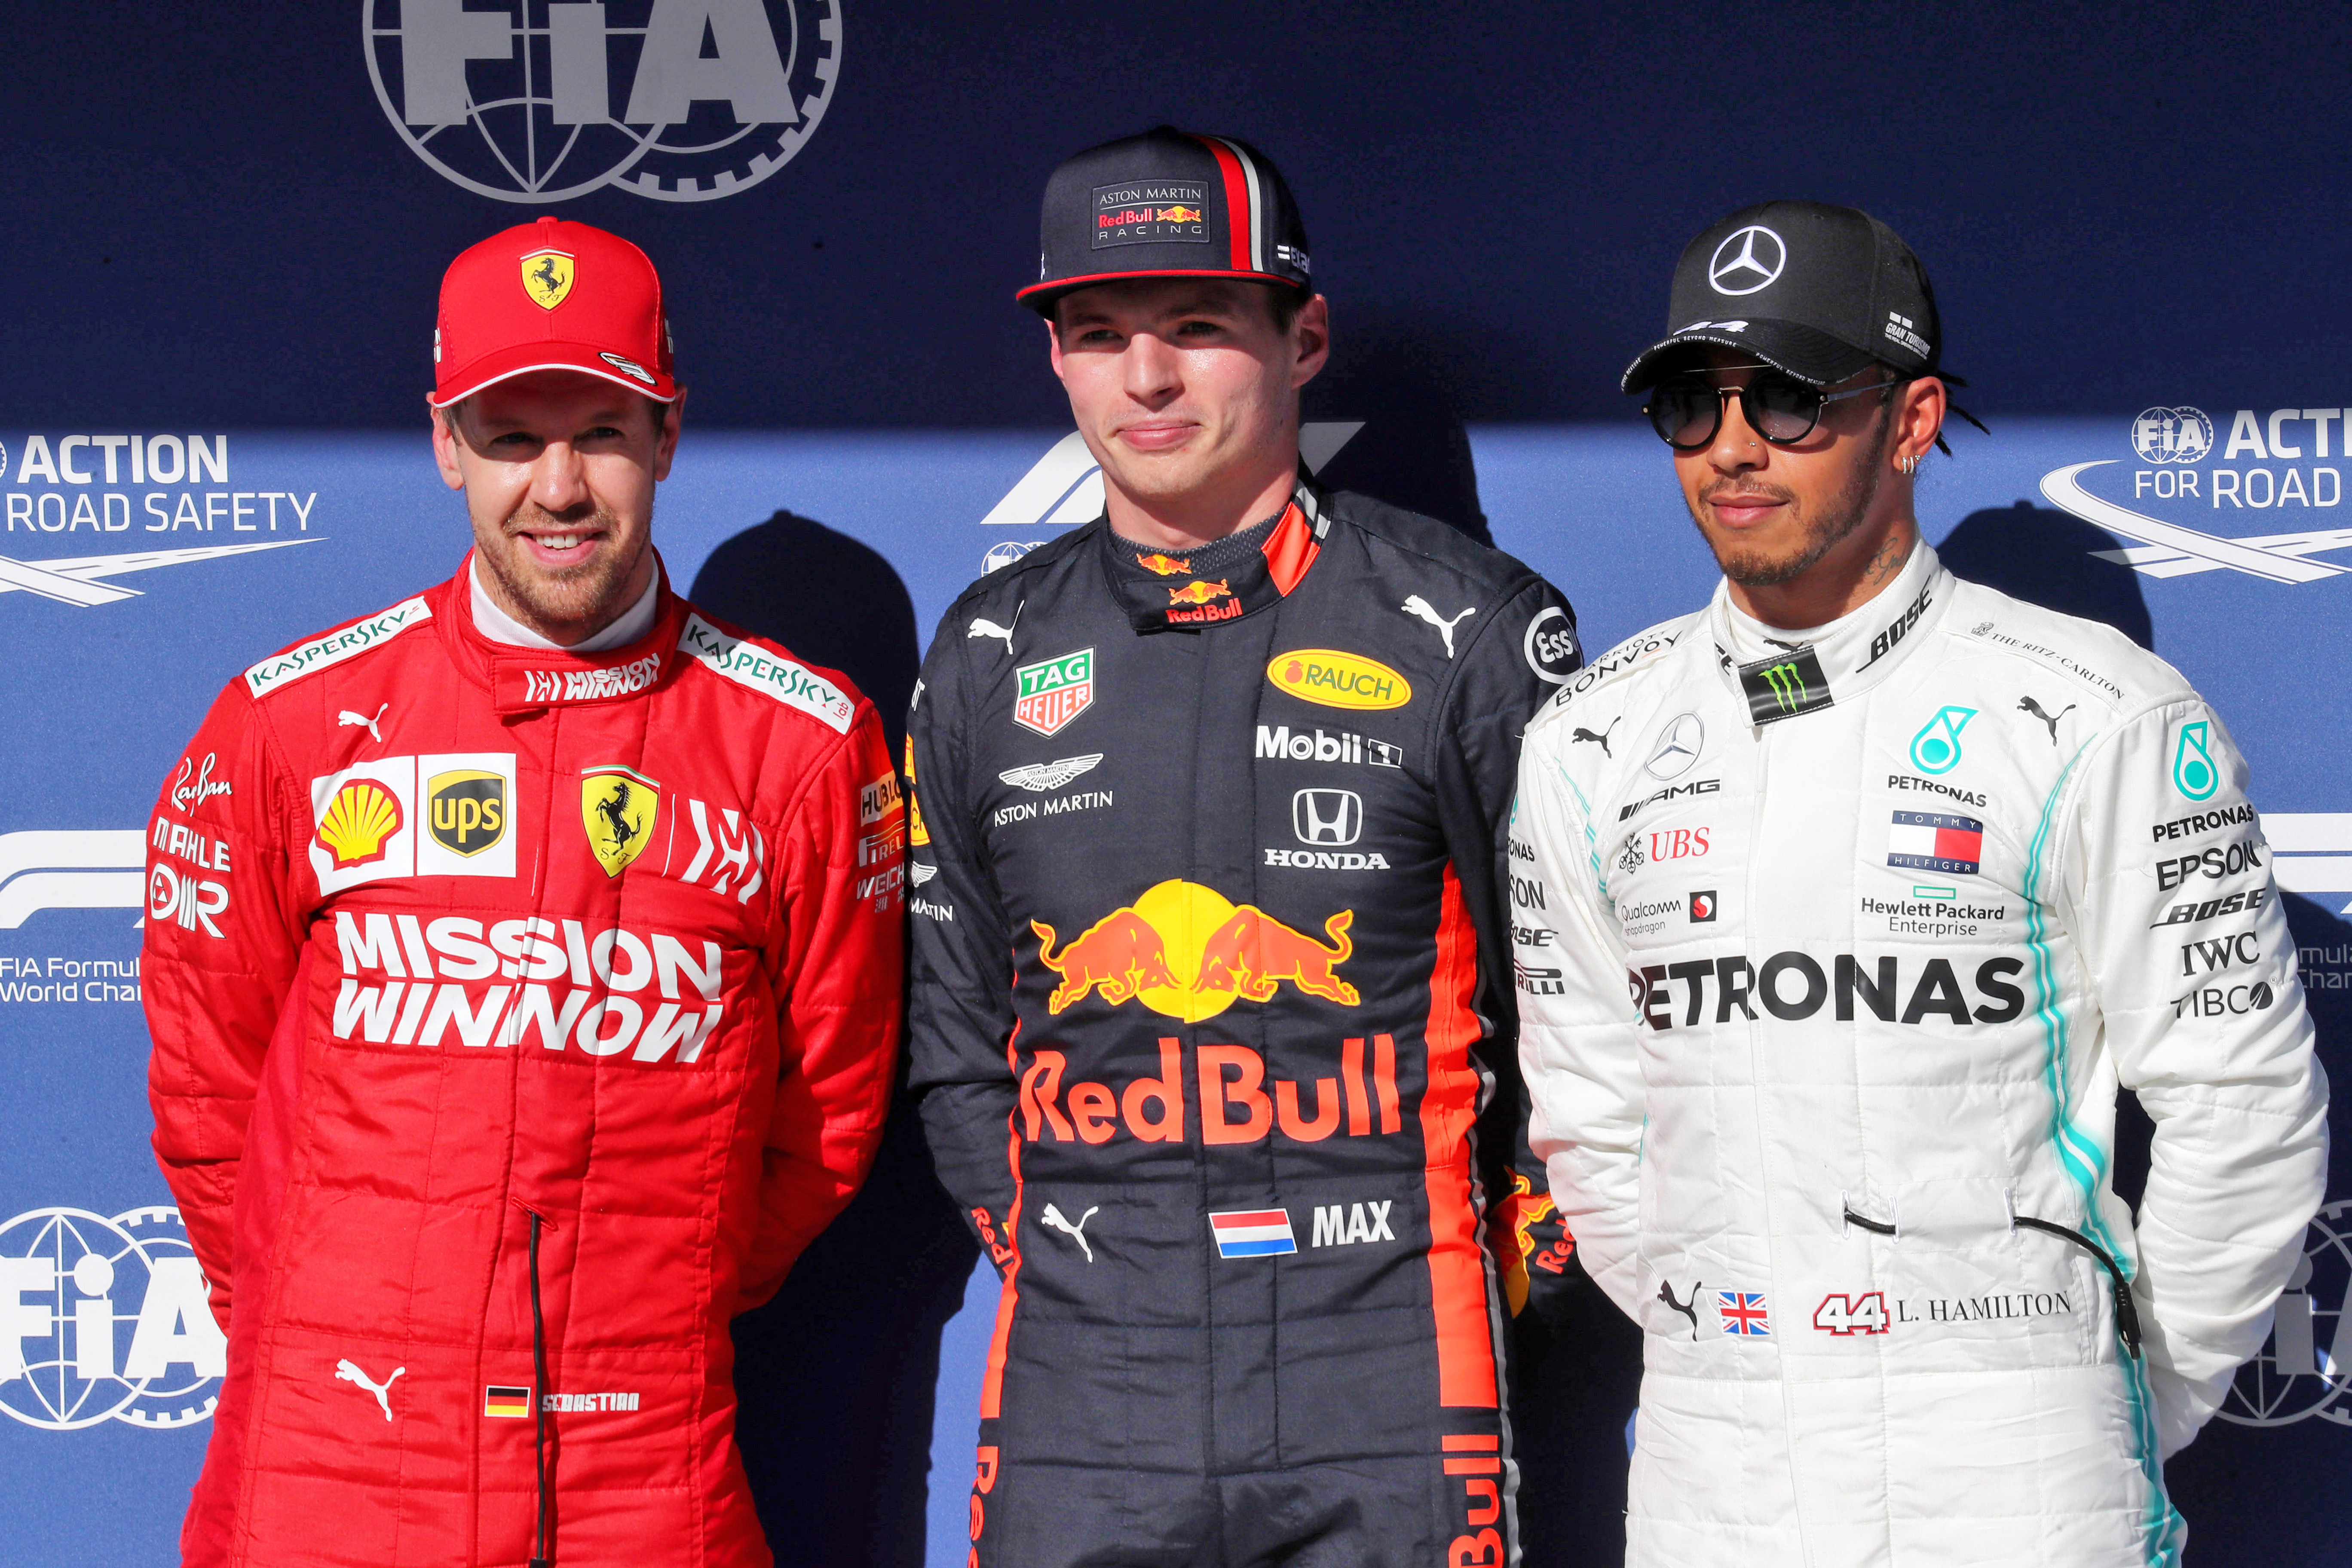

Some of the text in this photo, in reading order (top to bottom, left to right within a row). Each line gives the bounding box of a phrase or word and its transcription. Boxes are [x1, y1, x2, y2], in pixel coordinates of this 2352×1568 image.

[1099, 188, 1201, 205] ASTON MARTIN
[1099, 208, 1152, 228] Red Bull
[1099, 225, 1202, 240] RACING
[1654, 337, 1680, 351] POWERFUL
[1709, 337, 1737, 347] MEASURE
[1886, 322, 1930, 355] GRAN TURISMO
[1755, 352, 1783, 371] POWERFUL
[1785, 369, 1805, 381] BEYOND
[17, 434, 228, 484] ACTION
[2135, 467, 2341, 508] FOR ROAD
[6, 492, 317, 532] ROAD SAFETY
[1165, 597, 1243, 623] Red Bull
[1856, 574, 1932, 674] BOSE
[252, 610, 407, 687] KASPERSKY
[567, 652, 661, 686] MISSION
[687, 624, 849, 720] KASPERSKY lab
[1023, 657, 1085, 692] TAG
[1305, 664, 1393, 700] RAUCH
[1556, 630, 1684, 707] BONVOY
[1992, 633, 2125, 700] THE RITZ-CARLTON
[563, 668, 659, 701] WINNOW
[1020, 686, 1087, 728] HEUER
[1256, 725, 1361, 764] Mobil
[1027, 764, 1069, 777] ASTON MARTIN
[994, 790, 1113, 827] ASTON MARTIN
[1888, 775, 1987, 807] PETRONAS
[434, 797, 501, 843] ups
[1900, 814, 1976, 829] TOMMY
[2153, 803, 2254, 842] PETRONAS
[153, 816, 232, 872] MAHLE
[1264, 848, 1390, 870] HONDA
[1649, 827, 1710, 862] UBS
[1894, 857, 1972, 873] HILFIGER
[2156, 840, 2263, 891] EPSON
[1621, 900, 1681, 923] Qualcomm
[1861, 897, 2005, 919] Hewlett Packard
[2150, 888, 2266, 929] BOSE
[1625, 921, 1666, 937] snapdragon
[1889, 917, 1978, 937] Enterprise
[0, 957, 42, 978] FIA
[335, 911, 722, 1001] MISSION
[2181, 931, 2260, 977] IWC
[0, 982, 78, 1002] World
[333, 978, 723, 1063] WINNOW
[1019, 1033, 1401, 1145] Red Bull
[1311, 1200, 1395, 1248] MAX
[1813, 1290, 2072, 1336] 44 L. HAMILTON
[542, 1392, 640, 1412] SEBASTIAN
